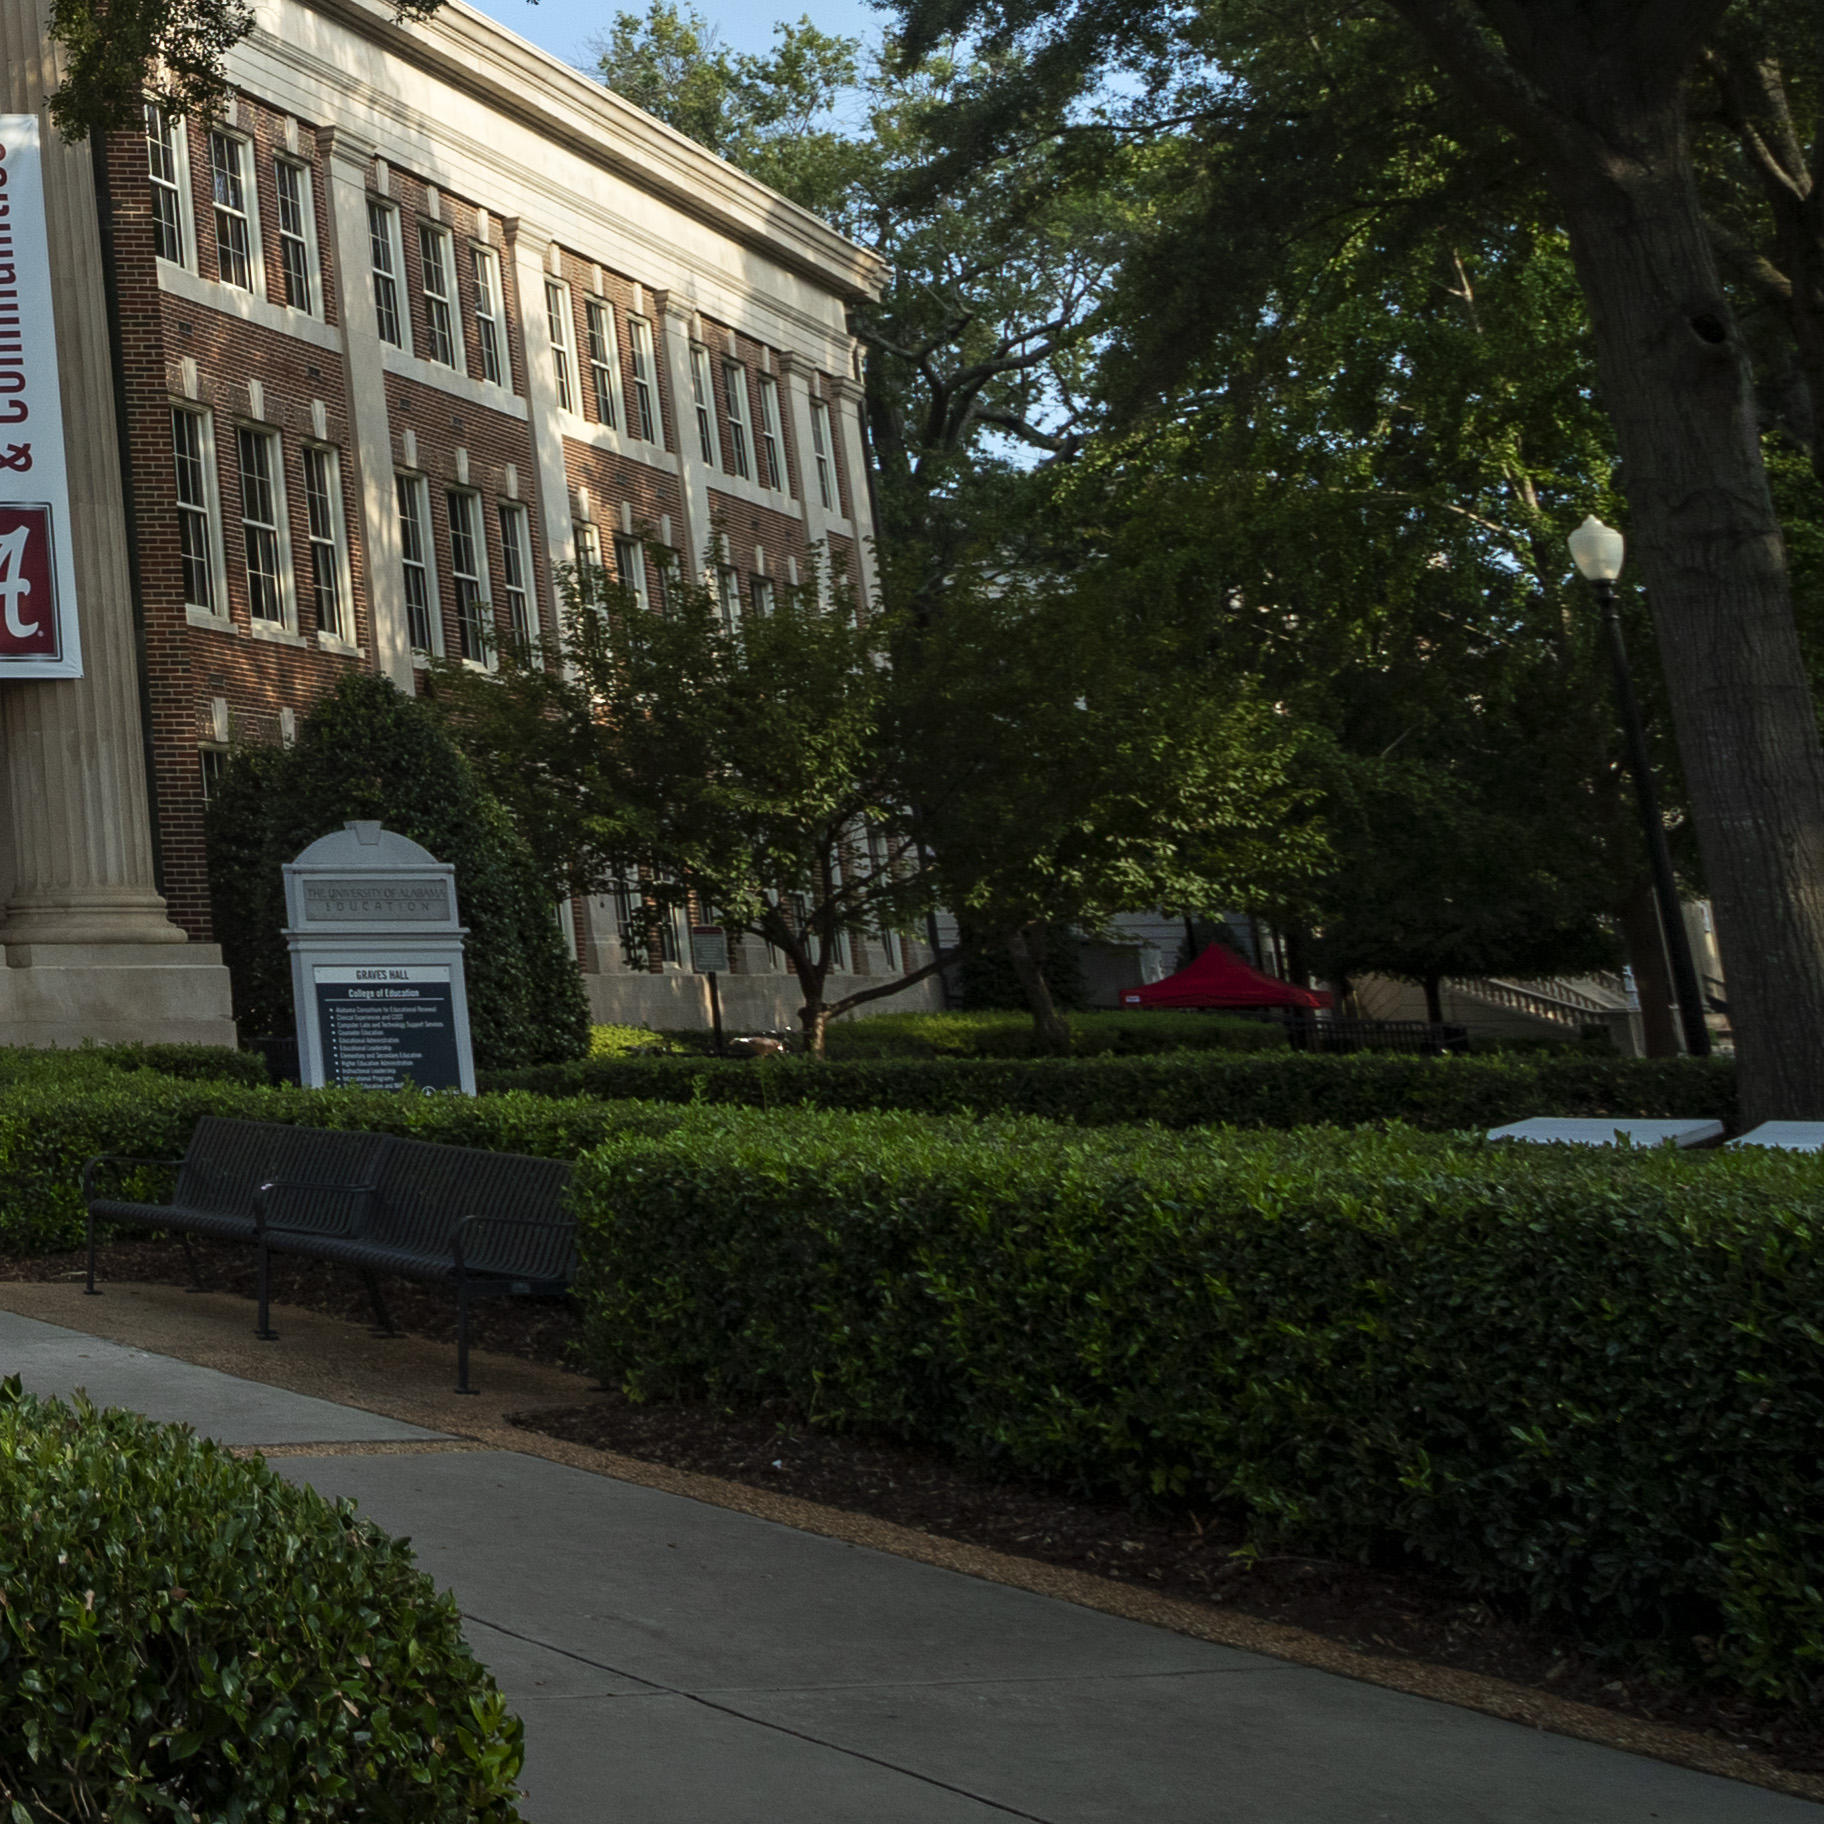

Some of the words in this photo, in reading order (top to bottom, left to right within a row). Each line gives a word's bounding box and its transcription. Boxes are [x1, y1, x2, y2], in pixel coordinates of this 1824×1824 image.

[307, 888, 326, 898] THE
[328, 888, 381, 898] UNIVERSITY
[399, 888, 444, 898] ALABAMA
[325, 901, 430, 912] EDUCATION
[355, 969, 387, 980] GRAVES
[389, 969, 409, 980] HALL
[348, 988, 374, 999] College
[376, 988, 383, 997] of
[385, 988, 419, 997] Education
